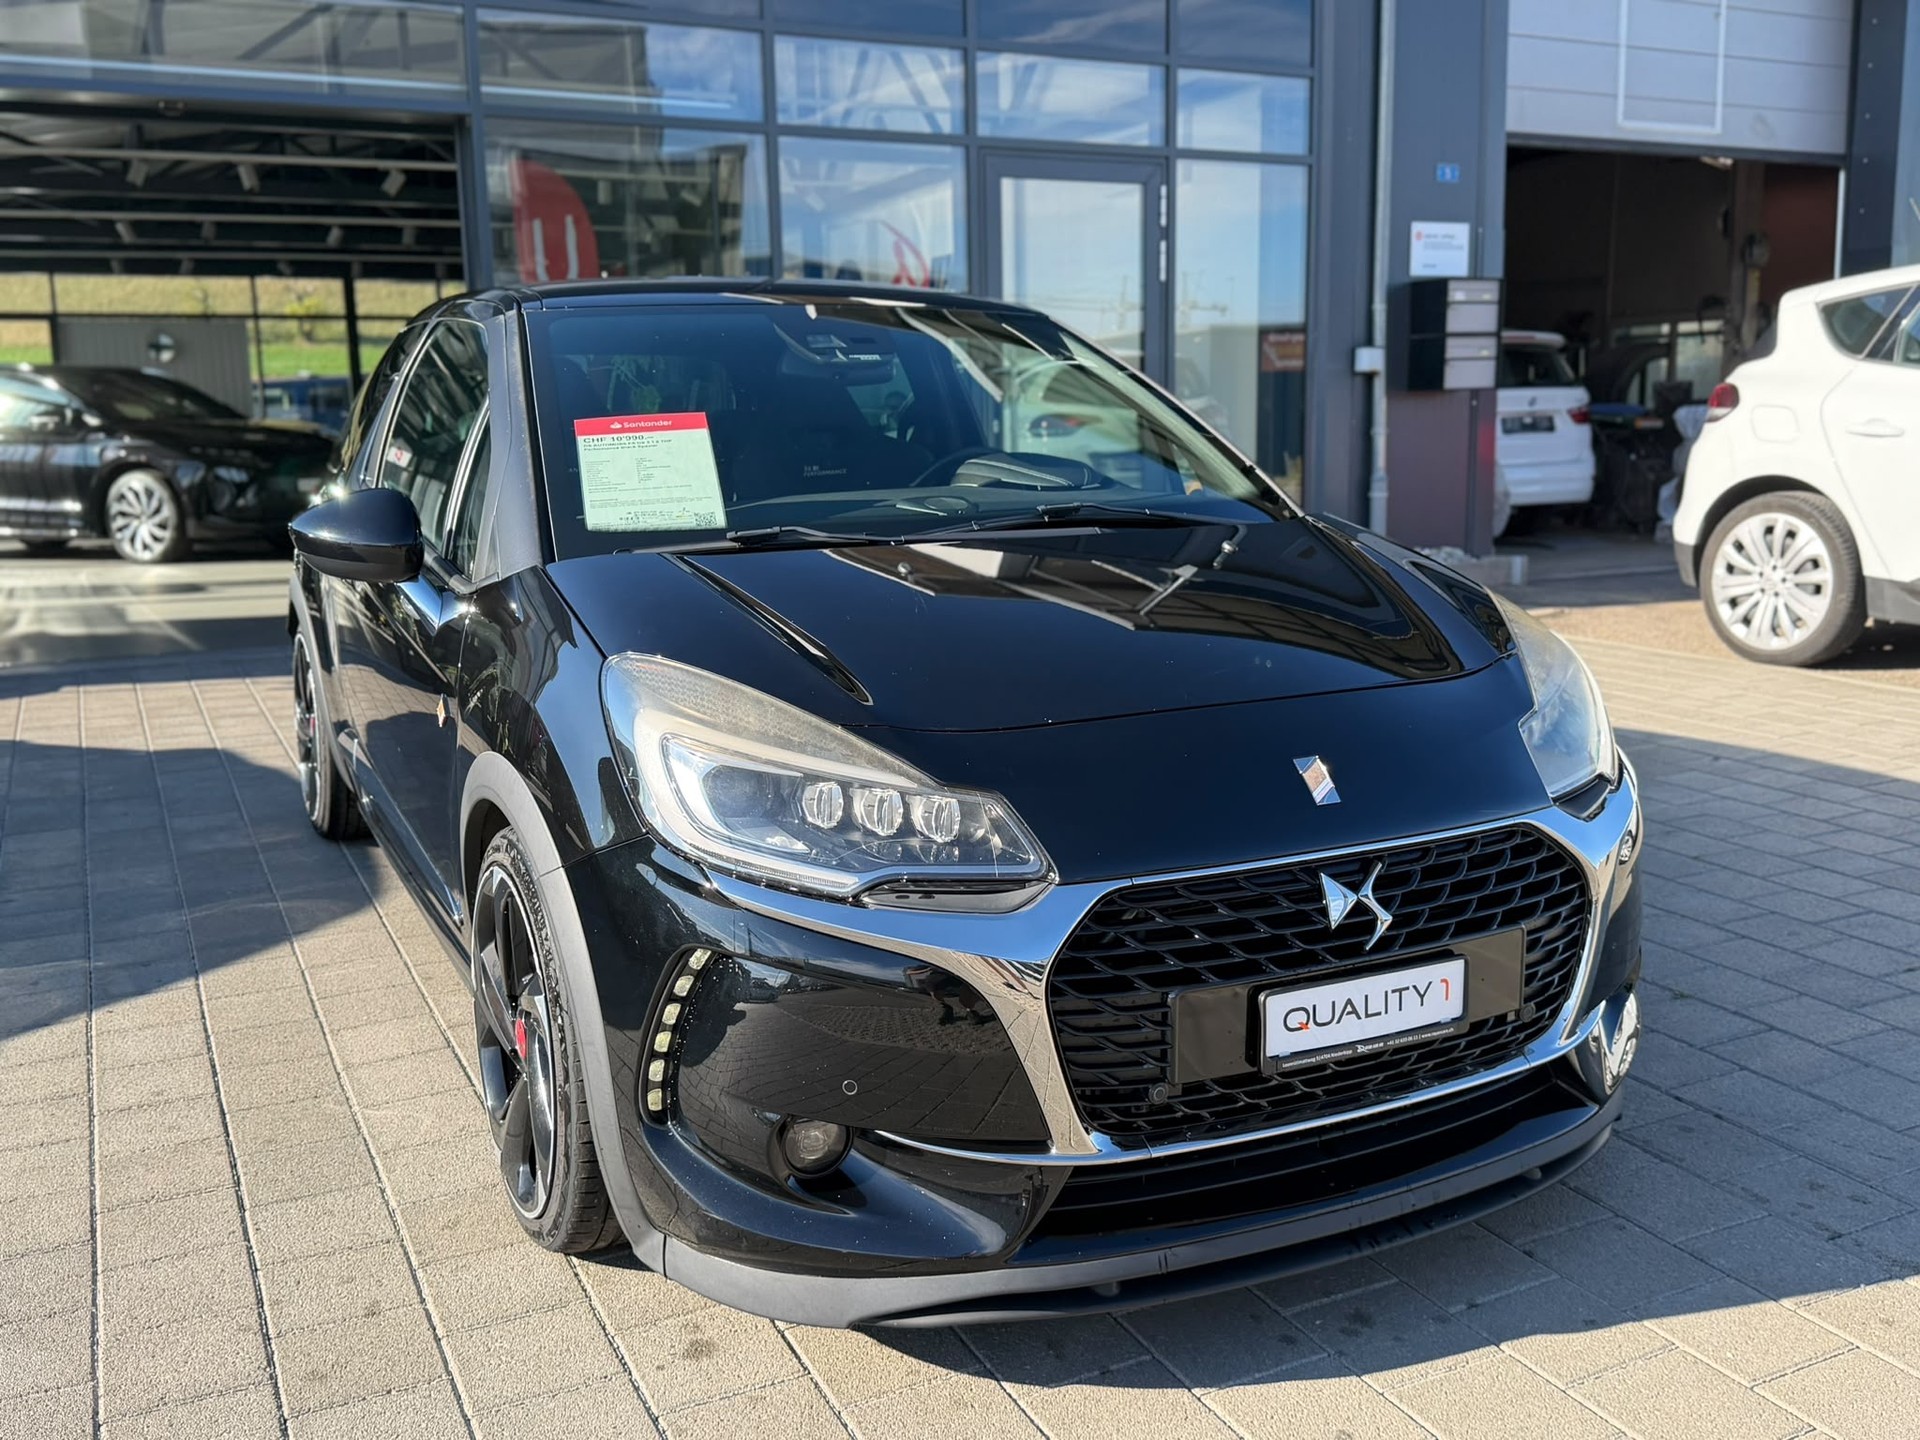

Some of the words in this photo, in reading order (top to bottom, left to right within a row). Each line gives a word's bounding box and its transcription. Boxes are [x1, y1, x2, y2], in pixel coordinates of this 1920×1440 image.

[623, 419, 673, 429] Santander
[1283, 981, 1433, 1033] QUALITY
[1440, 977, 1453, 1001] 1
